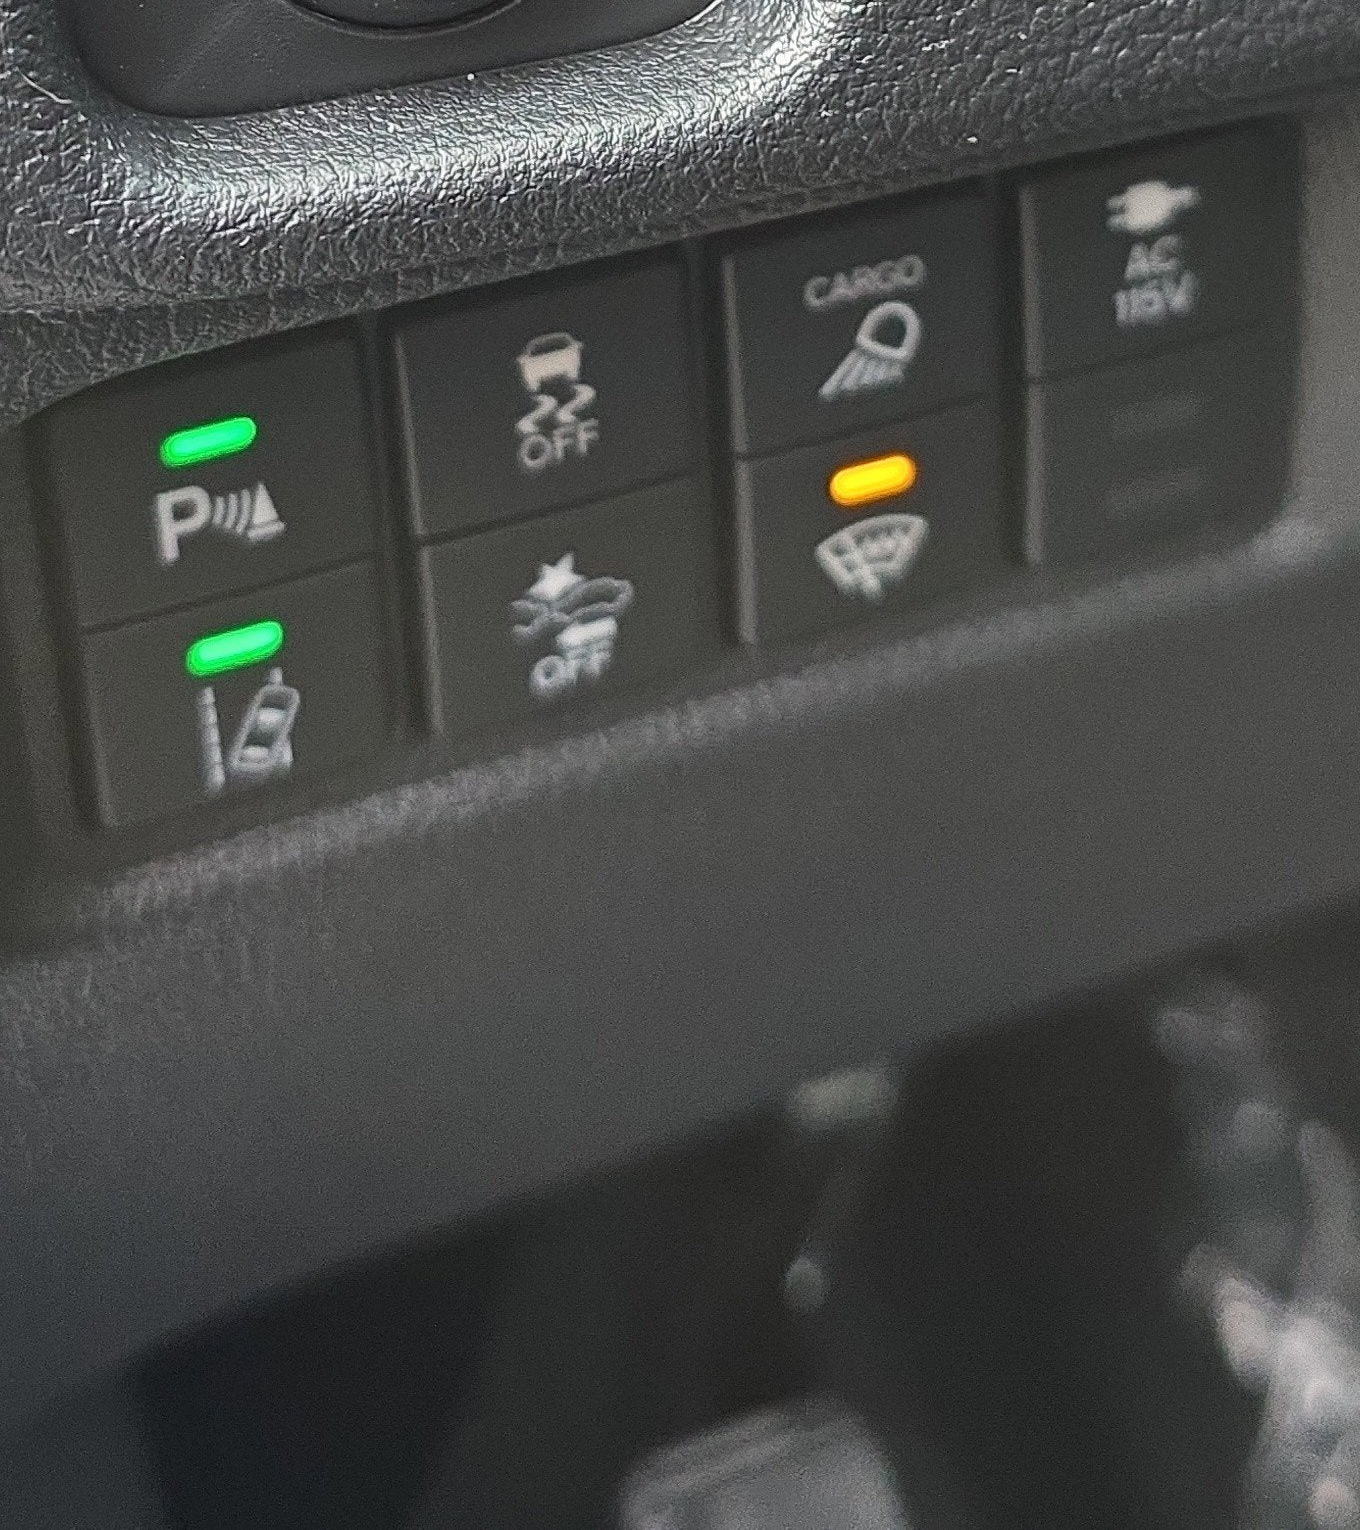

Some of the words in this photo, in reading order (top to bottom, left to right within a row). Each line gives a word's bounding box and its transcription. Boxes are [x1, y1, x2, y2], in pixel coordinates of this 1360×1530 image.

[803, 254, 927, 310] CARGO
[519, 417, 601, 470] OFF
[154, 484, 212, 564] P
[530, 637, 613, 696] OFF
